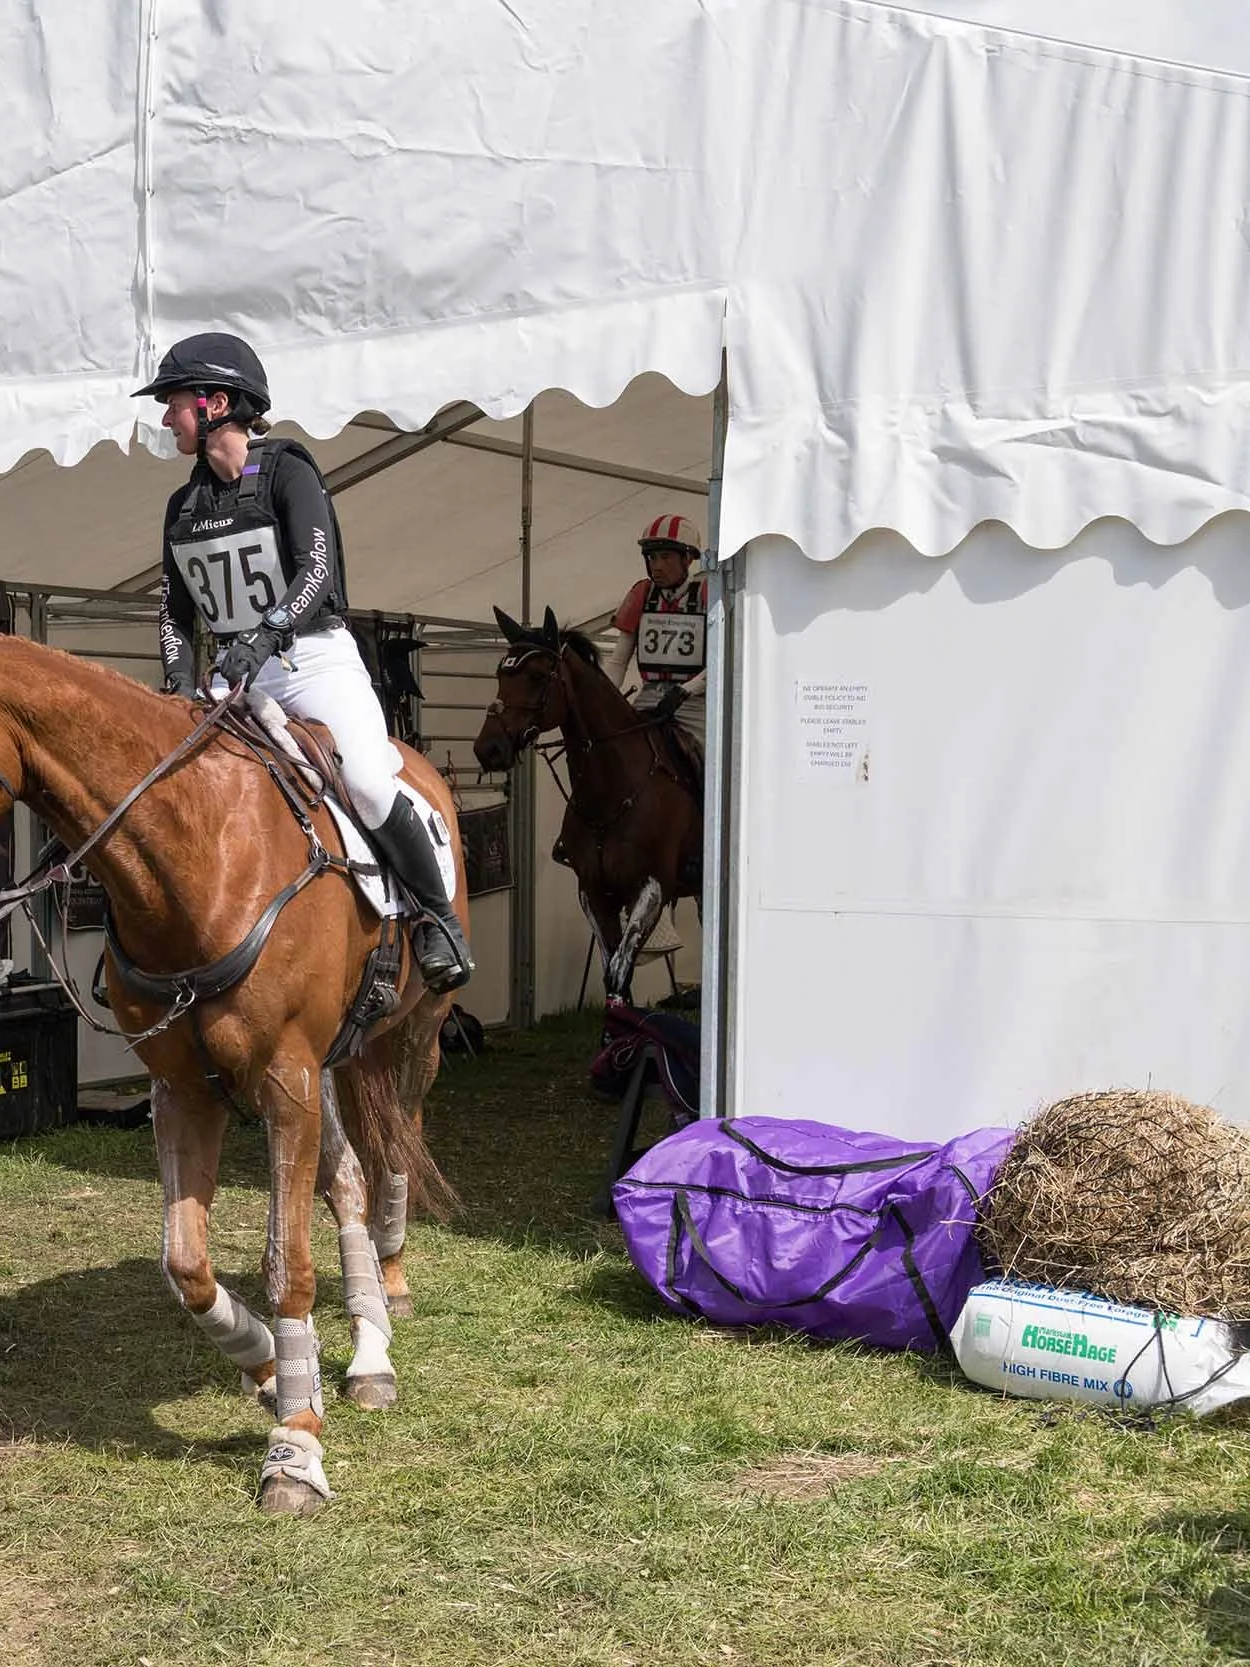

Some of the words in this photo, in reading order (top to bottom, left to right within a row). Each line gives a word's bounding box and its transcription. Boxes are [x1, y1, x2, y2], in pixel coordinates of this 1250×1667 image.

[187, 543, 278, 624] 375
[644, 628, 695, 656] 373
[1001, 1286, 1046, 1299] Original
[1003, 1361, 1036, 1378] HIGH
[1039, 1368, 1079, 1387] FIBRE
[1083, 1377, 1110, 1393] MIX
